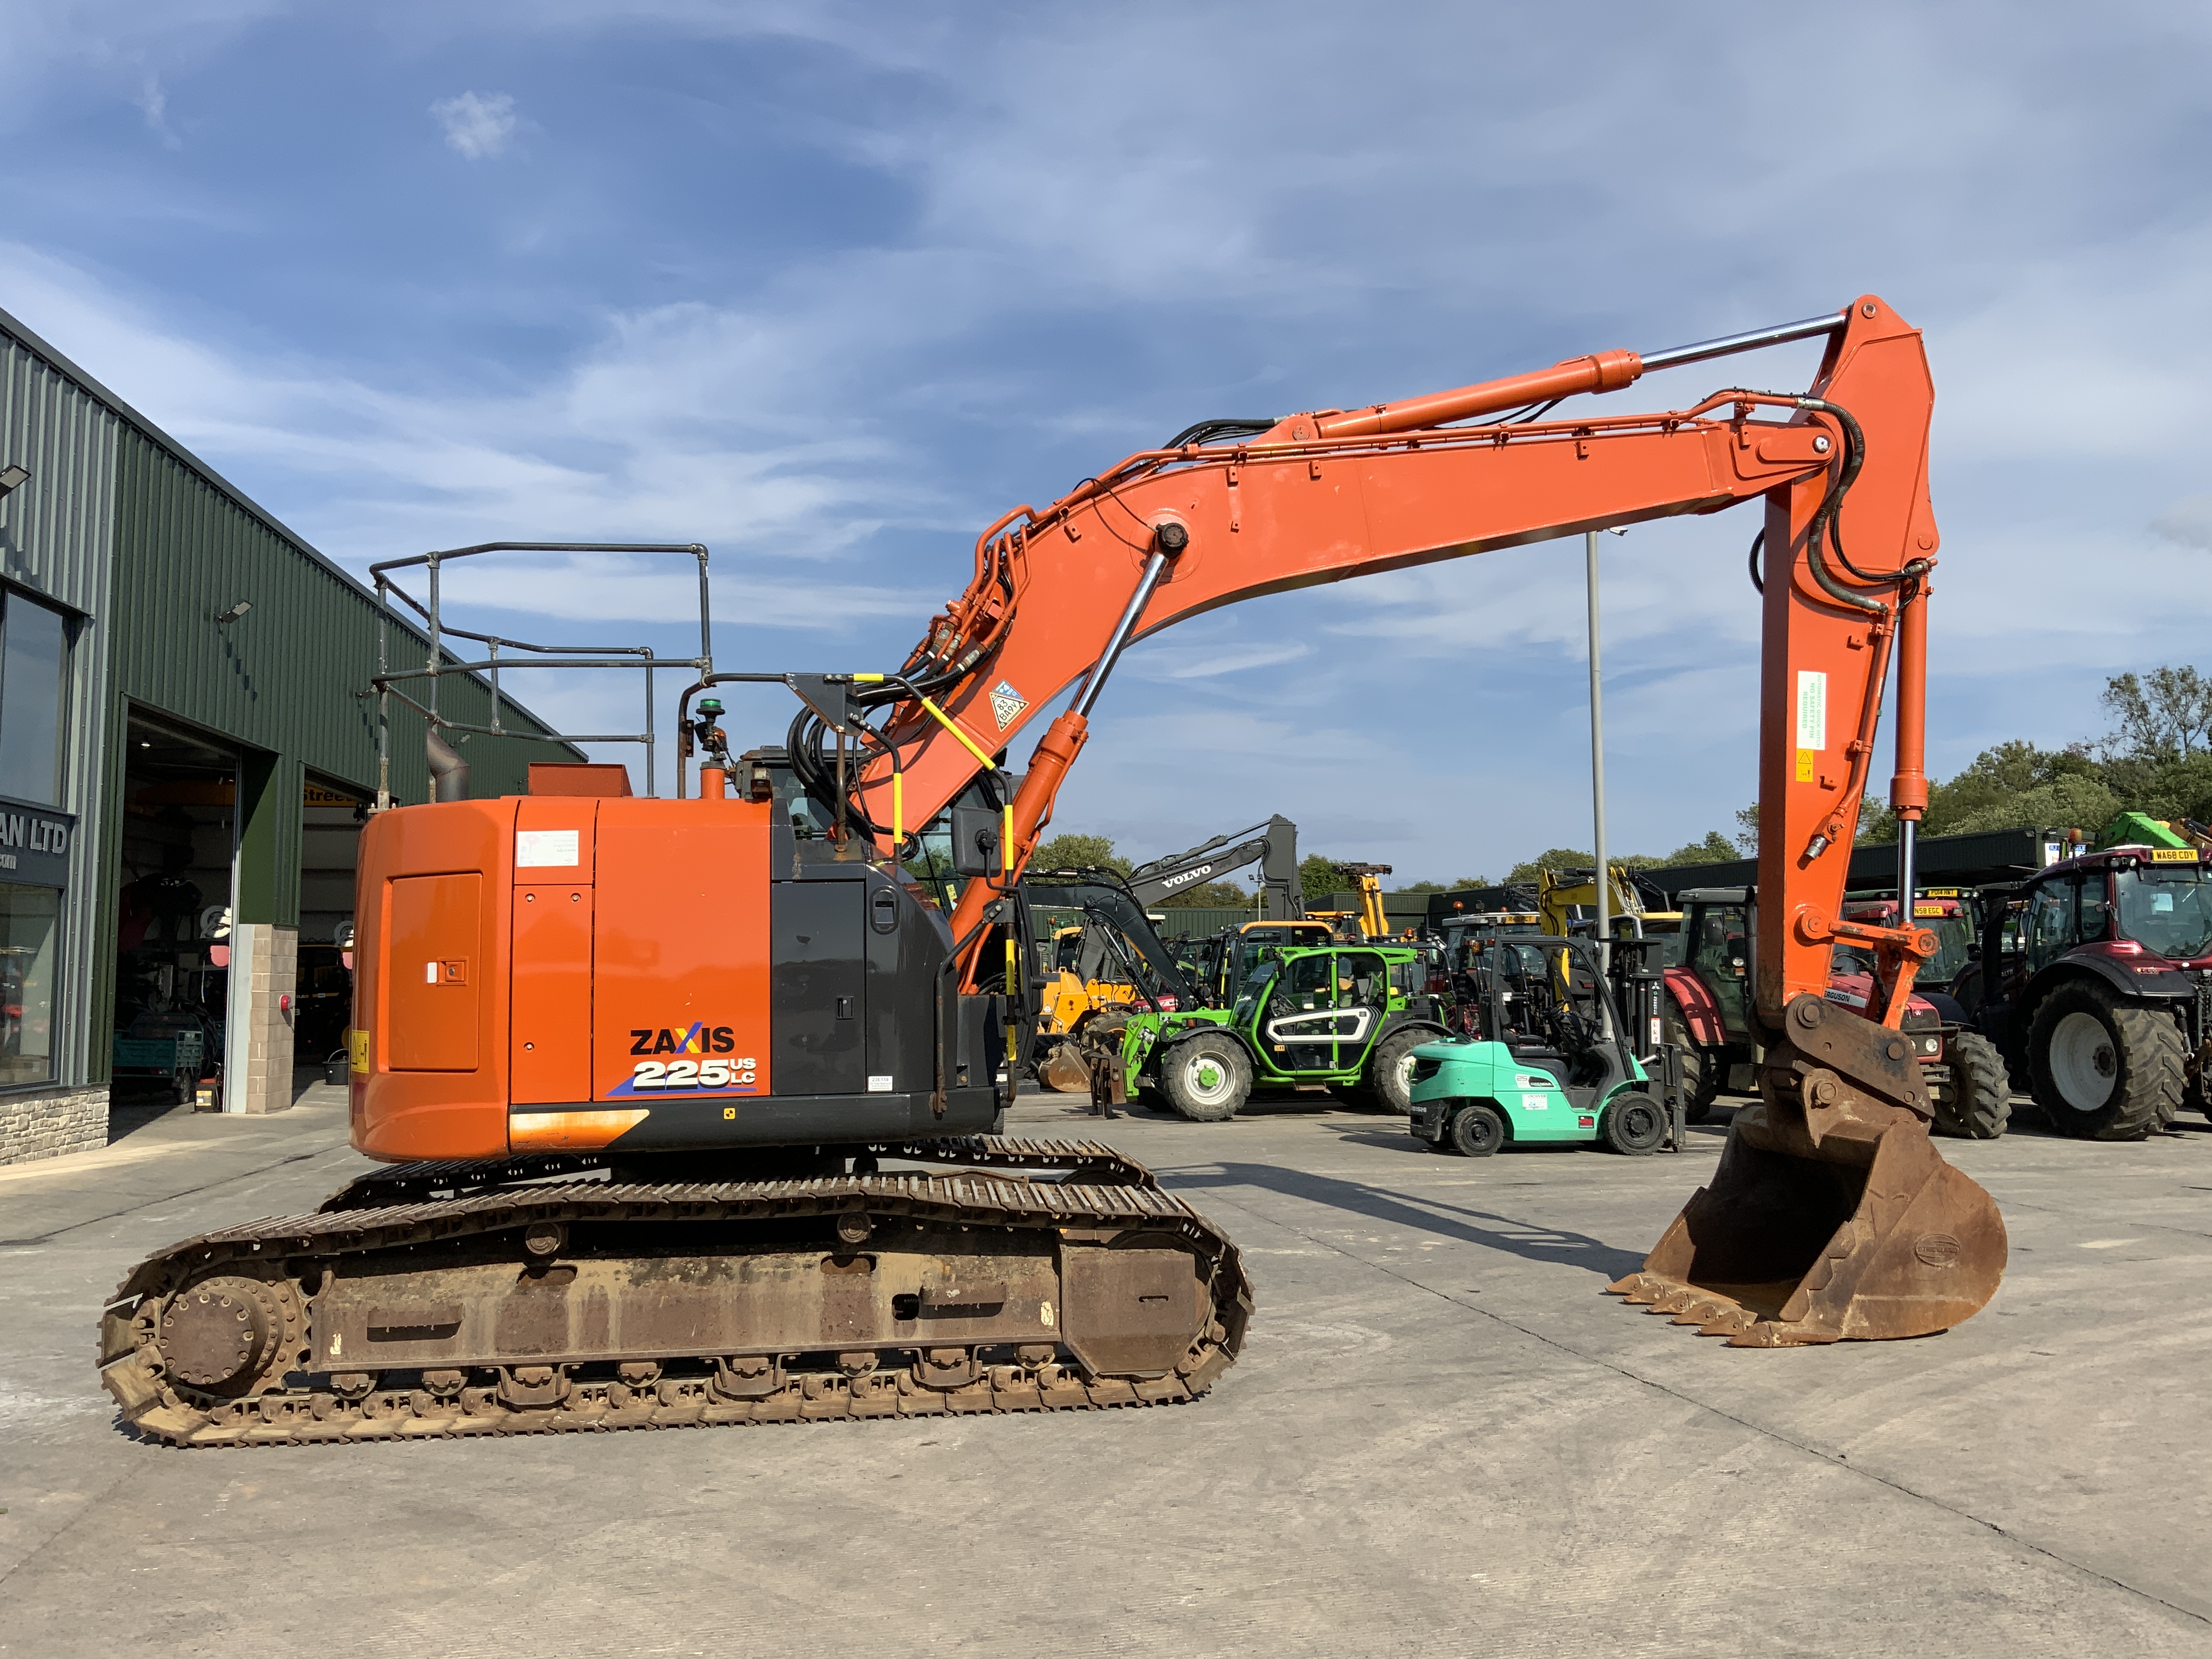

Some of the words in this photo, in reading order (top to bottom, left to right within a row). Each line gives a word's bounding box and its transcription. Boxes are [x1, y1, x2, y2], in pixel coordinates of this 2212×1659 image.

[1810, 682, 1815, 693] NO
[997, 699, 1008, 710] 83
[999, 702, 1018, 721] BA9Y
[30, 818, 67, 854] LTD
[2157, 851, 2177, 859] WA68
[2179, 851, 2194, 859] CDY
[1161, 865, 1211, 888] VOLVO
[630, 1021, 735, 1056] ZAXIS
[633, 1060, 730, 1091] 225
[730, 1058, 757, 1070] US
[730, 1071, 756, 1085] LC
